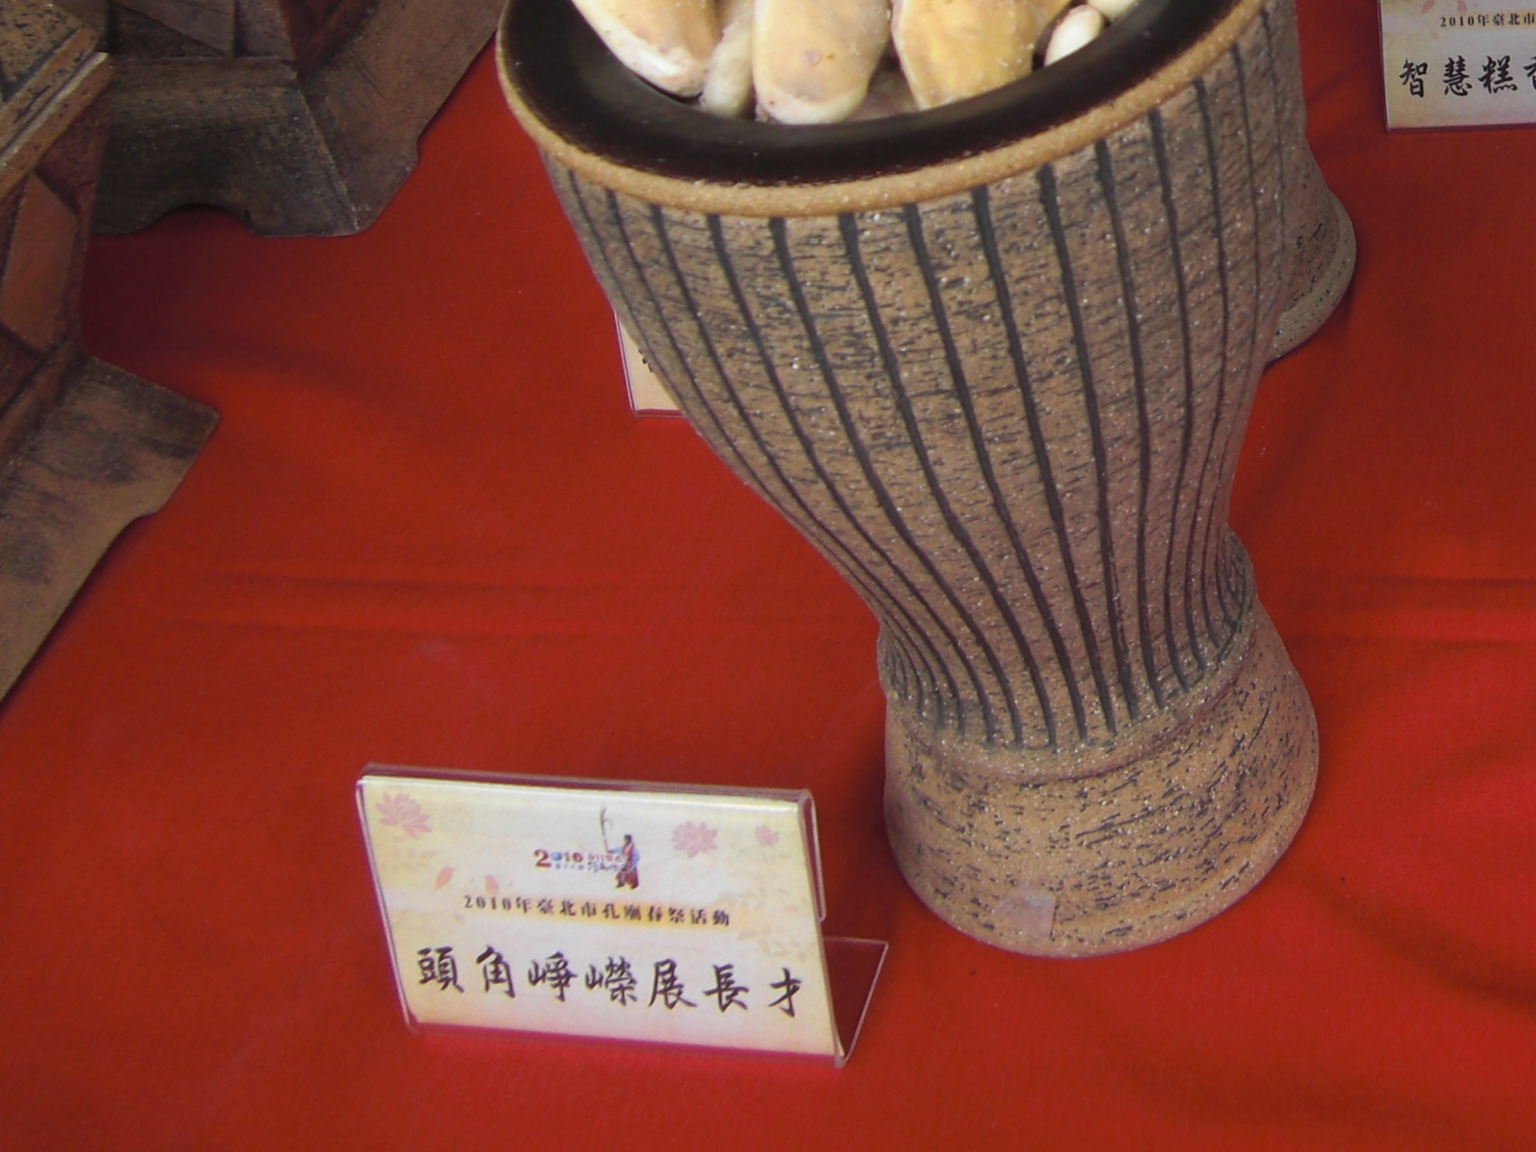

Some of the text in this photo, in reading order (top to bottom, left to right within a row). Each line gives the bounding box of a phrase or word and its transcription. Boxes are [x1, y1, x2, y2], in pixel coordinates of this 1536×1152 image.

[463, 894, 731, 927] 2010年臺北市孔廟春祭活動
[417, 945, 803, 1017] 頭角崢嶸展長才
